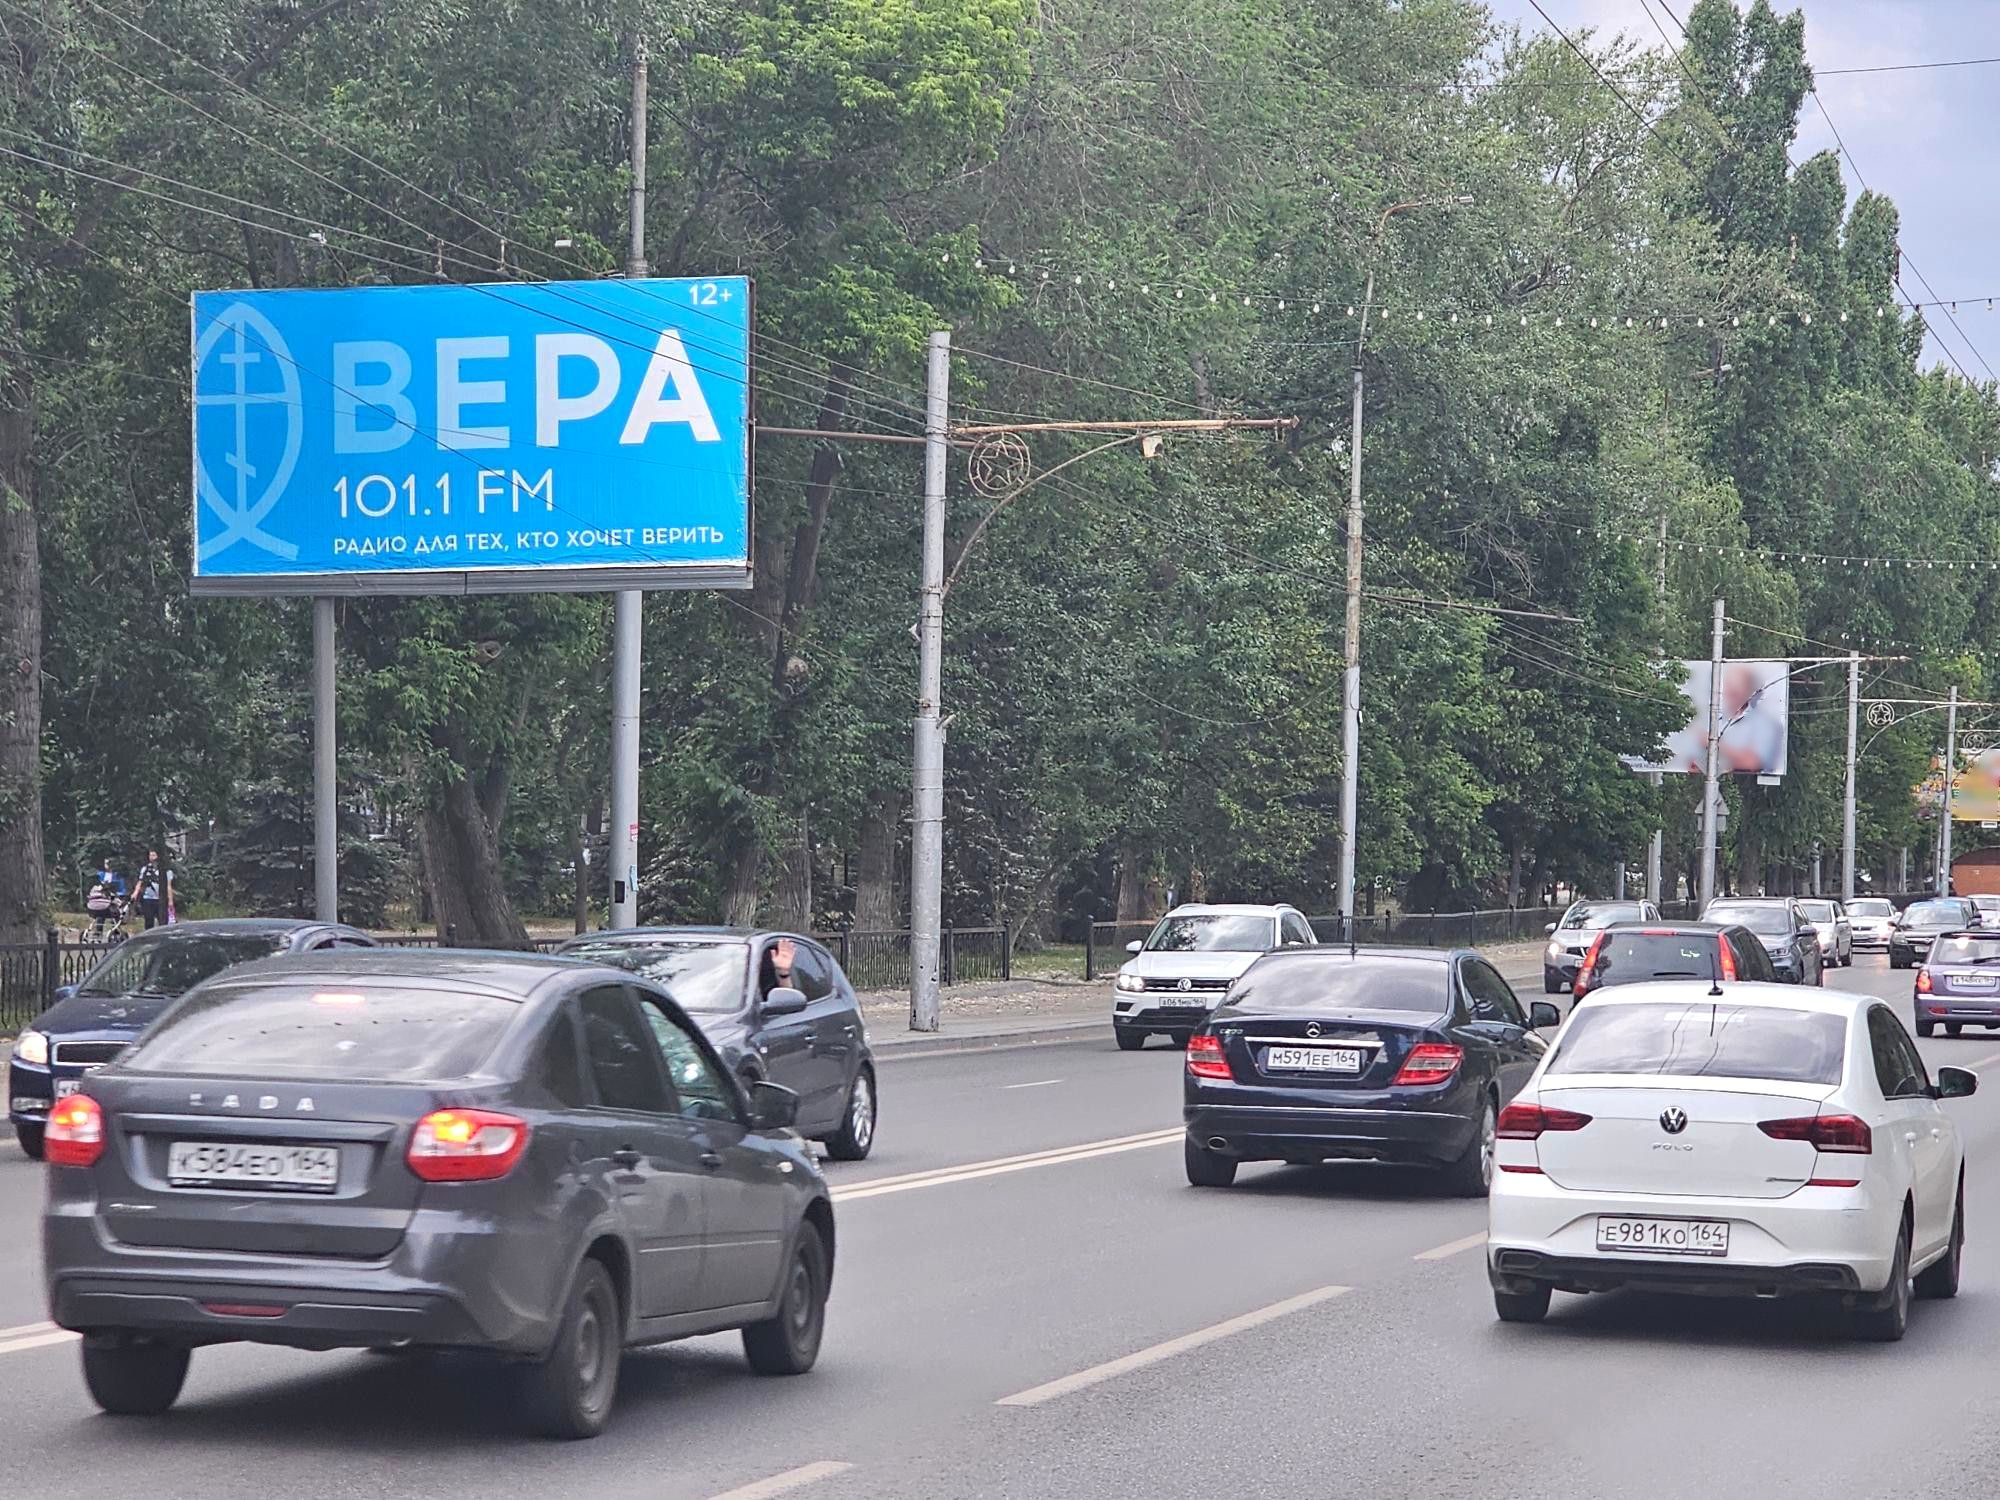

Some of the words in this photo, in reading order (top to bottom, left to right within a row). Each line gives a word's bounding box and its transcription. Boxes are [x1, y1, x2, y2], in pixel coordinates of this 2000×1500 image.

[689, 283, 732, 305] 12+
[332, 329, 722, 455] ВЕРА
[333, 472, 450, 518] 101.1
[477, 468, 553, 513] FM
[333, 535, 407, 556] РАДИО
[414, 534, 457, 555] ДЛЯ
[465, 532, 509, 552] ТЕХ,
[517, 530, 559, 549] КТО
[566, 527, 635, 548] ХОЧЕТ
[642, 525, 724, 545] ВЕРИТЬ
[1272, 1050, 1331, 1066] М591ЕЕ
[1334, 1051, 1357, 1064] 164
[1652, 1143, 1694, 1152] POLO
[287, 1150, 331, 1171] 164
[1605, 1222, 1687, 1245] Е981КО
[1690, 1224, 1723, 1241] 164
